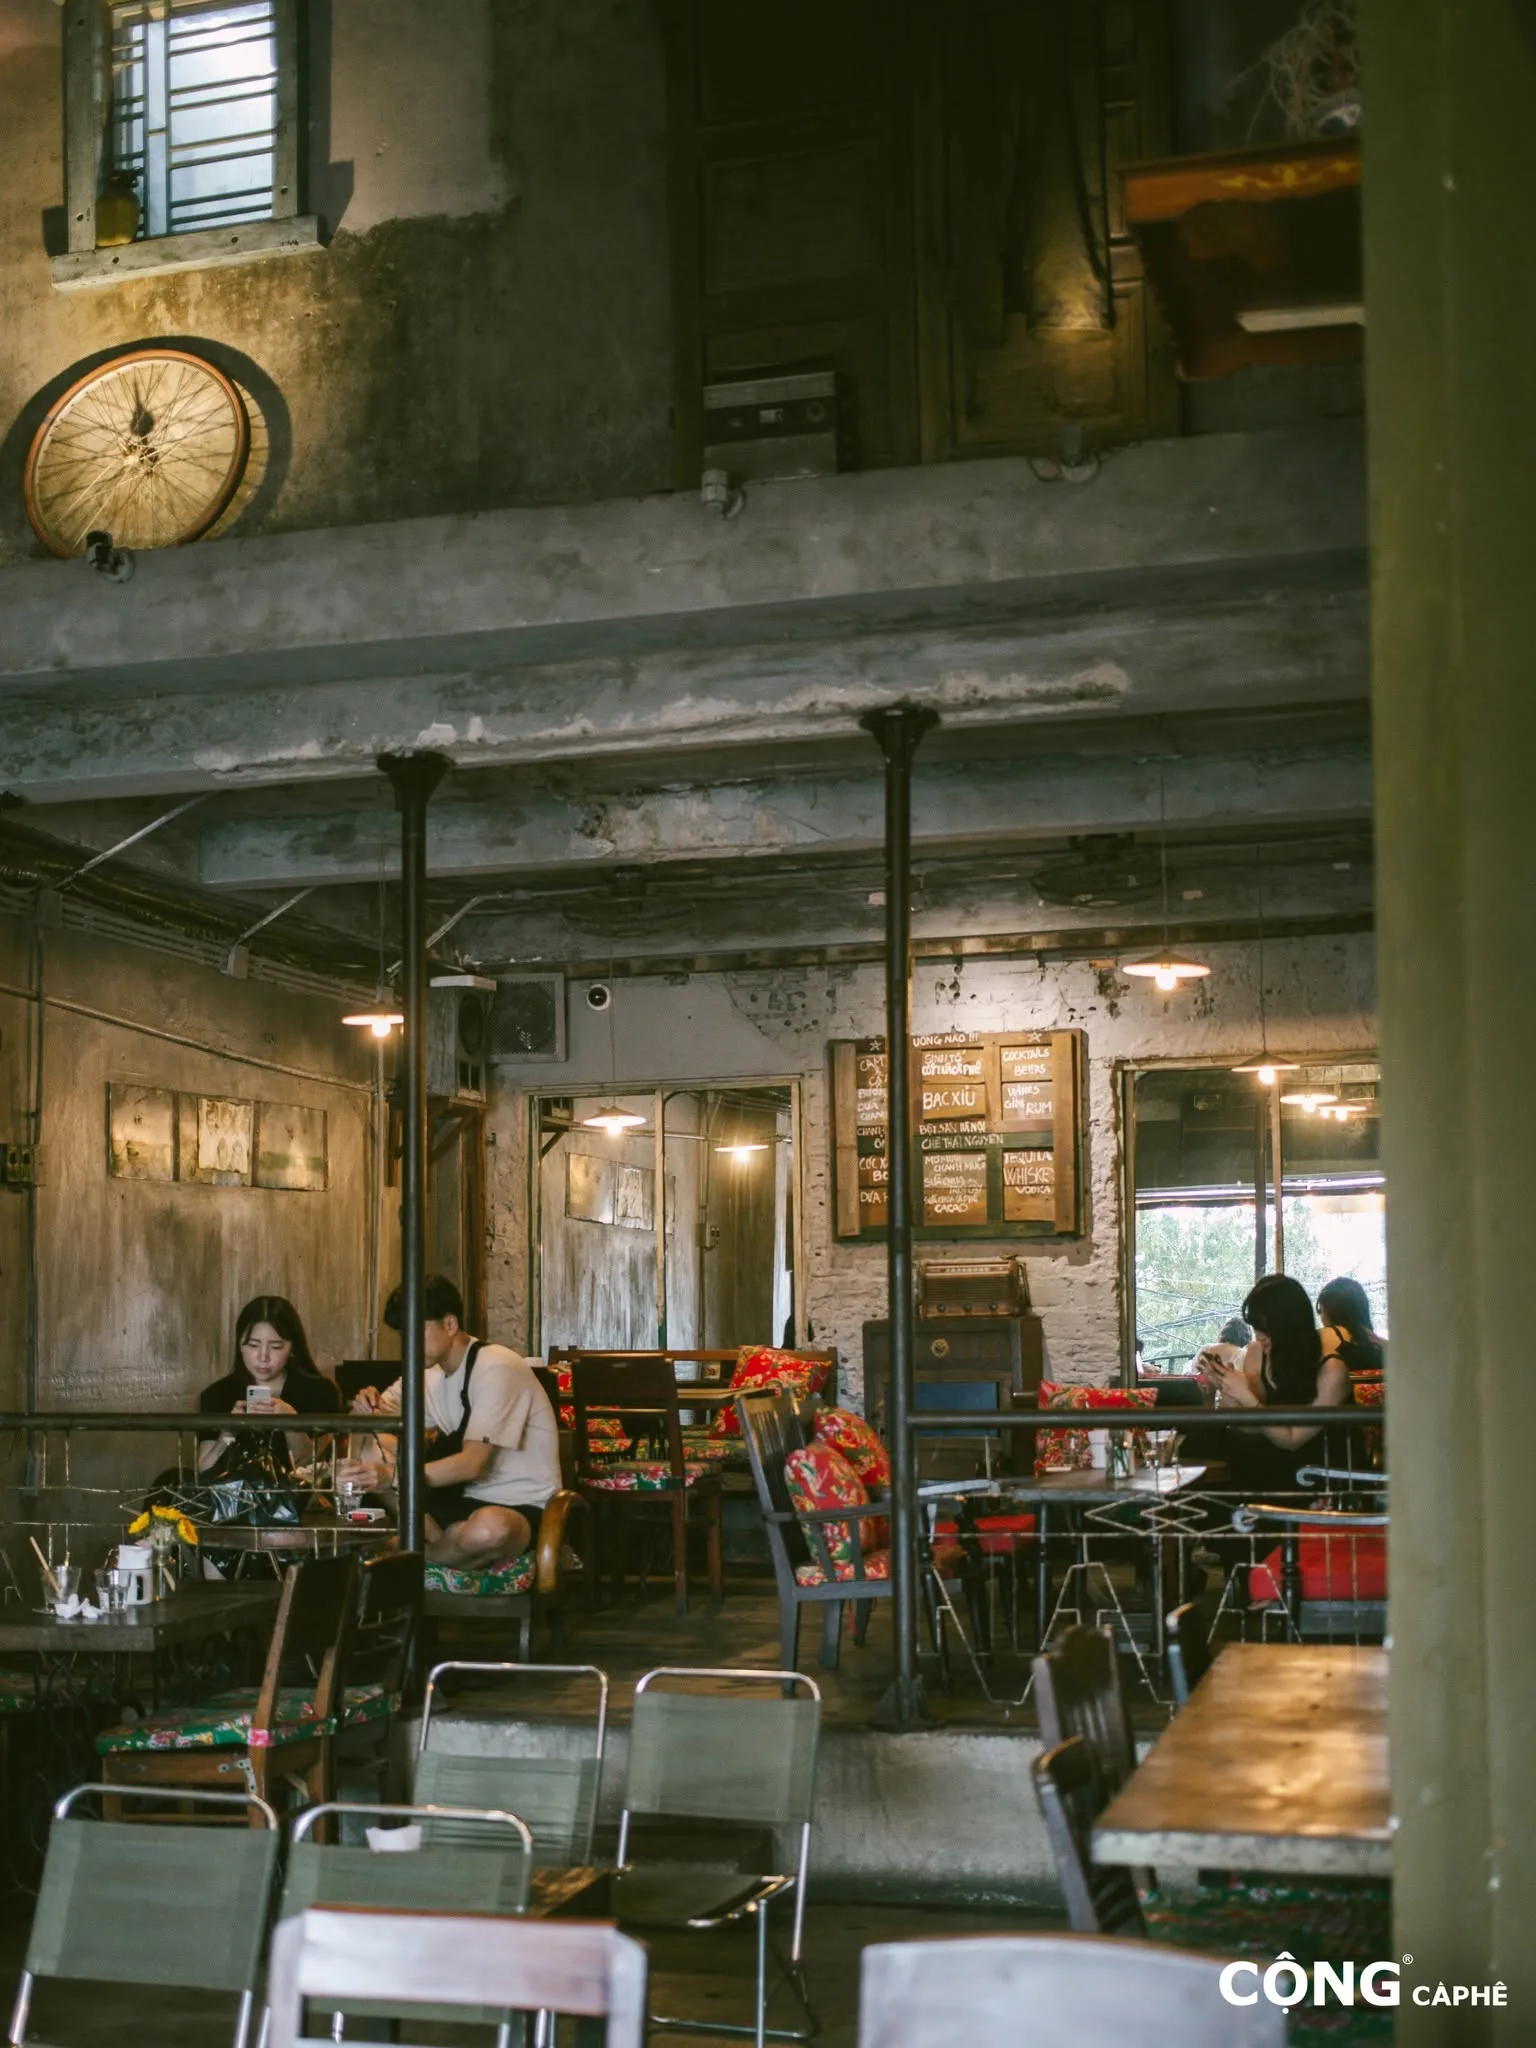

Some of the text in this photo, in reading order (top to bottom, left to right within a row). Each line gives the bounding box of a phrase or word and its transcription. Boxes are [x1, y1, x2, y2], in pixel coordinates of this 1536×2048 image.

[1001, 1047, 1050, 1062] COCKTAILS
[1014, 1063, 1047, 1077] BEERS
[1024, 1101, 1052, 1115] RUM
[1003, 1151, 1053, 1165] TEQUILA
[1014, 1185, 1051, 1195] VODKA
[934, 1204, 969, 1213] CACAO
